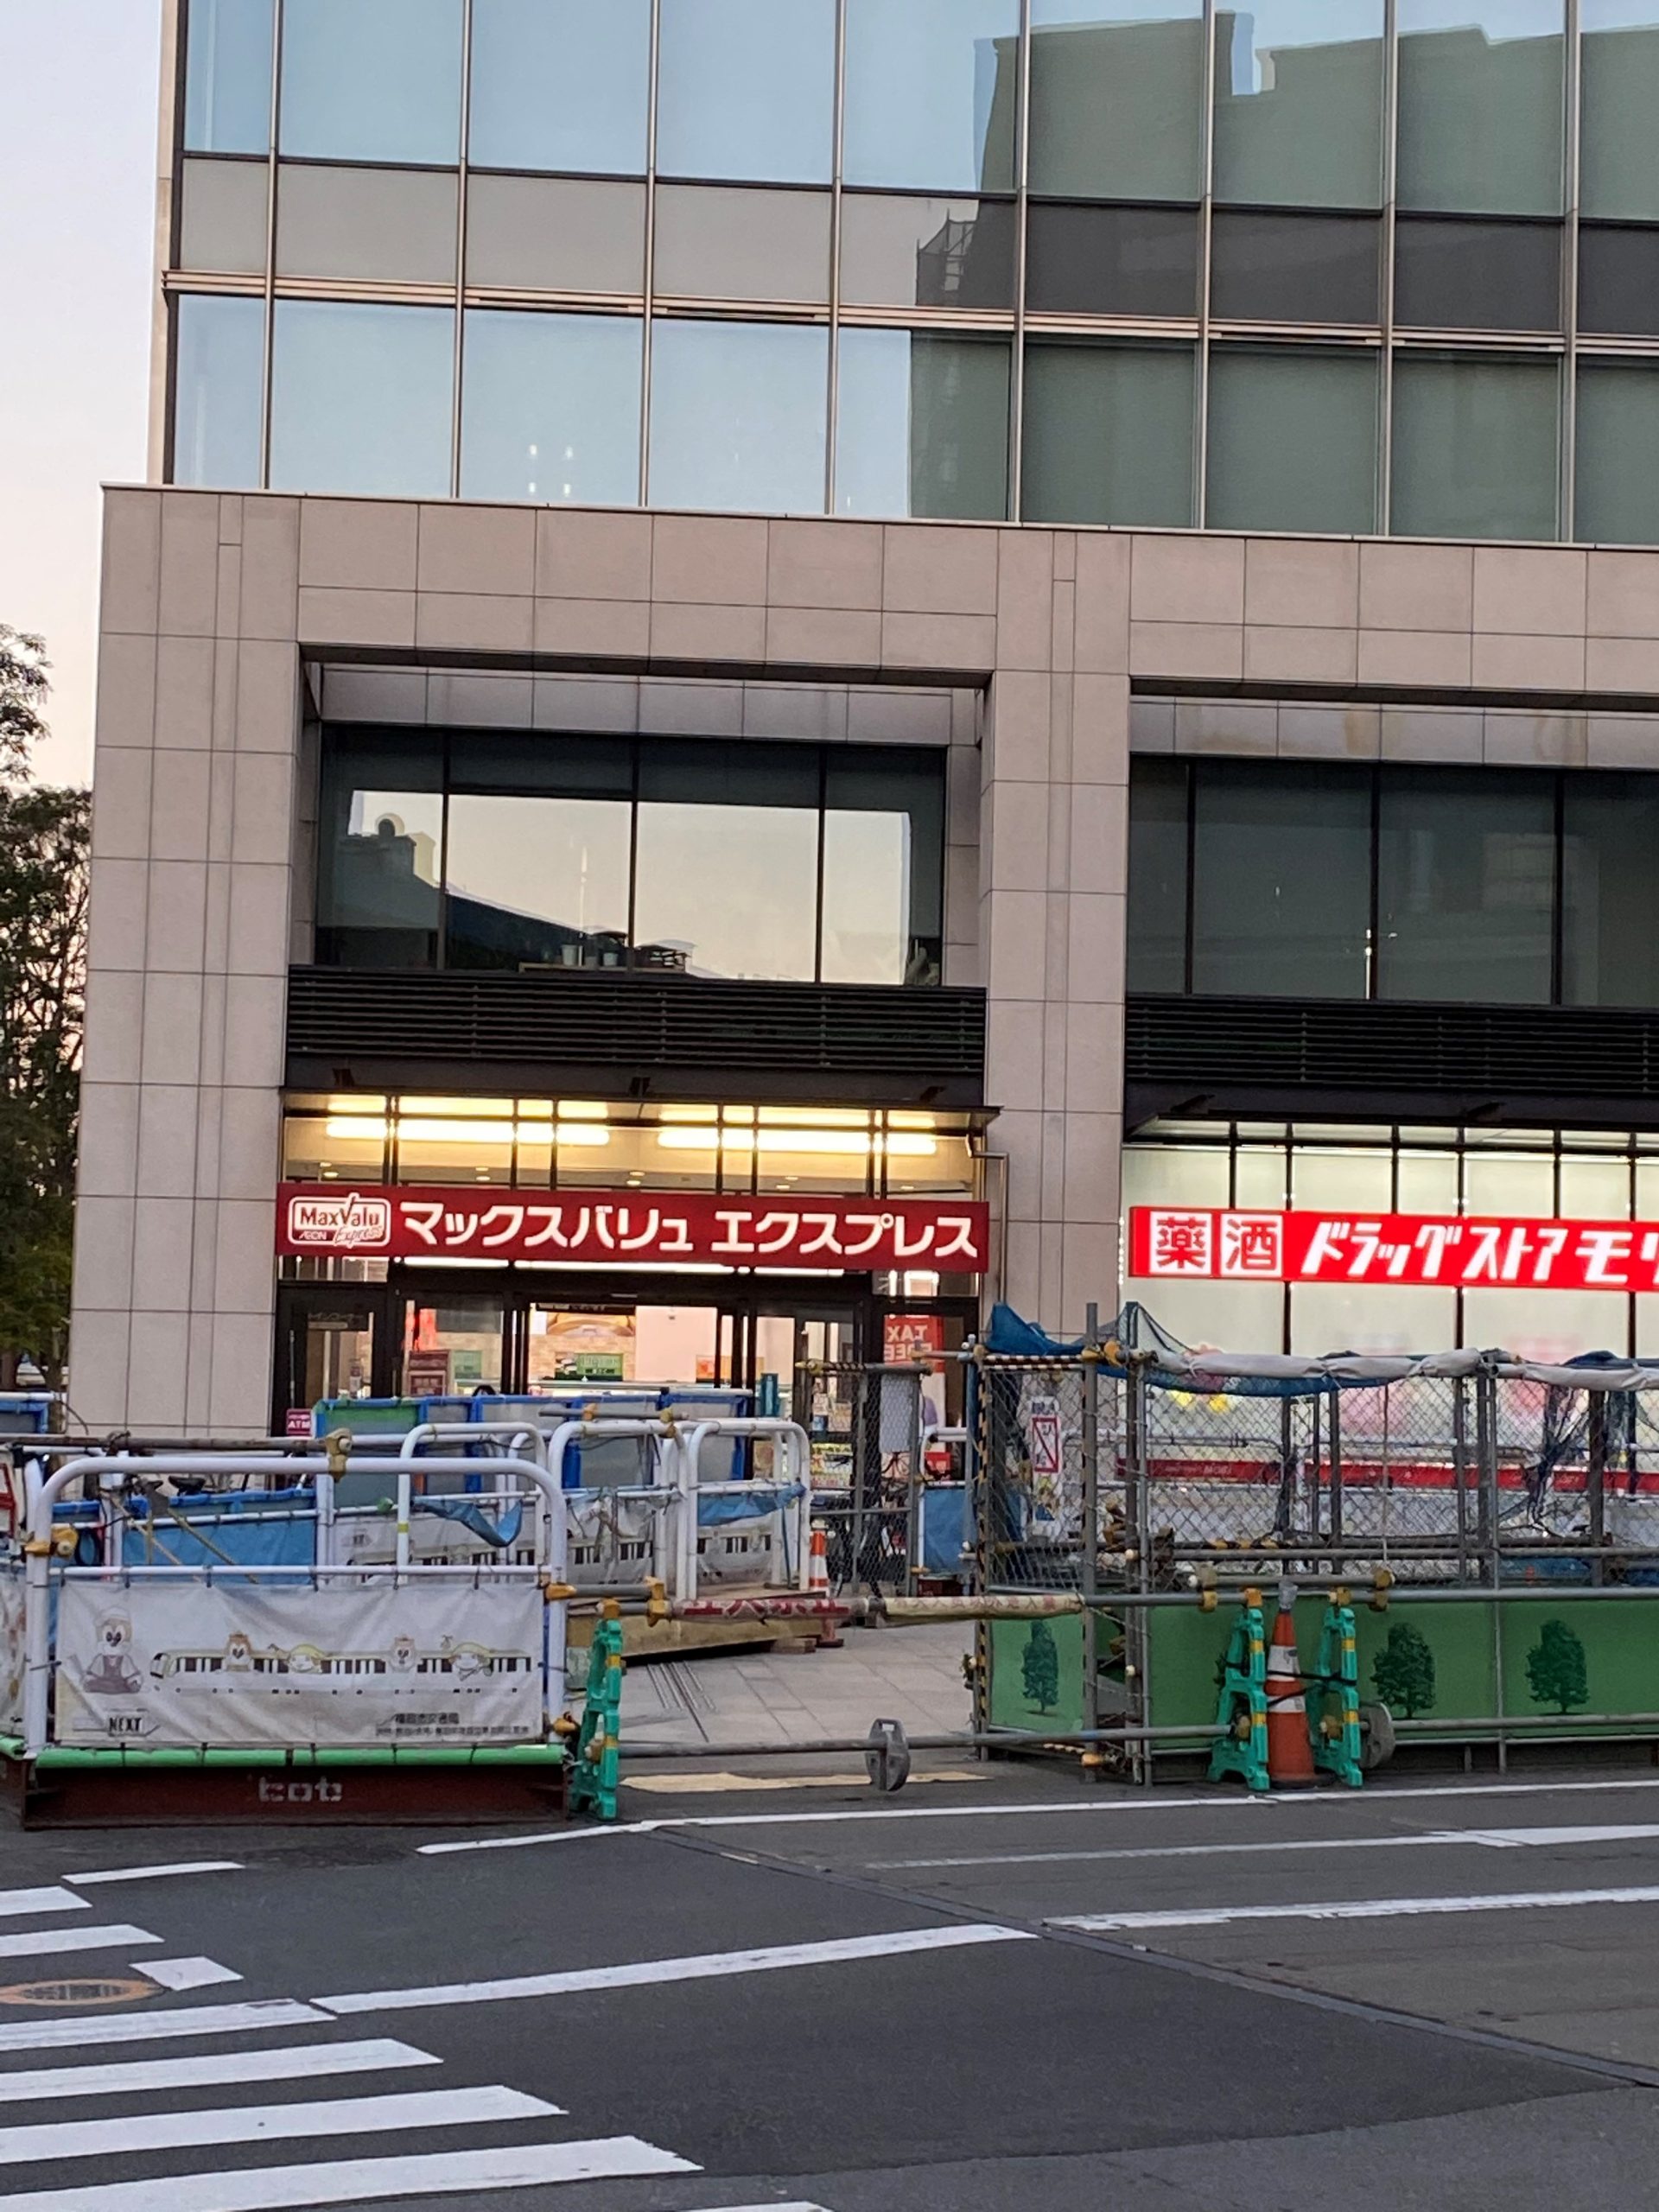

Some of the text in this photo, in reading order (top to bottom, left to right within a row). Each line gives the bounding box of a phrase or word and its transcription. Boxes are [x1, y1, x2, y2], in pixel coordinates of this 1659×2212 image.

[299, 1196, 380, 1227] MaxValu
[399, 1201, 978, 1258] マックスバリュ エクスプレス
[1156, 1216, 1206, 1270] 薬
[1225, 1217, 1278, 1272] 酒
[288, 1420, 311, 1429] ATM
